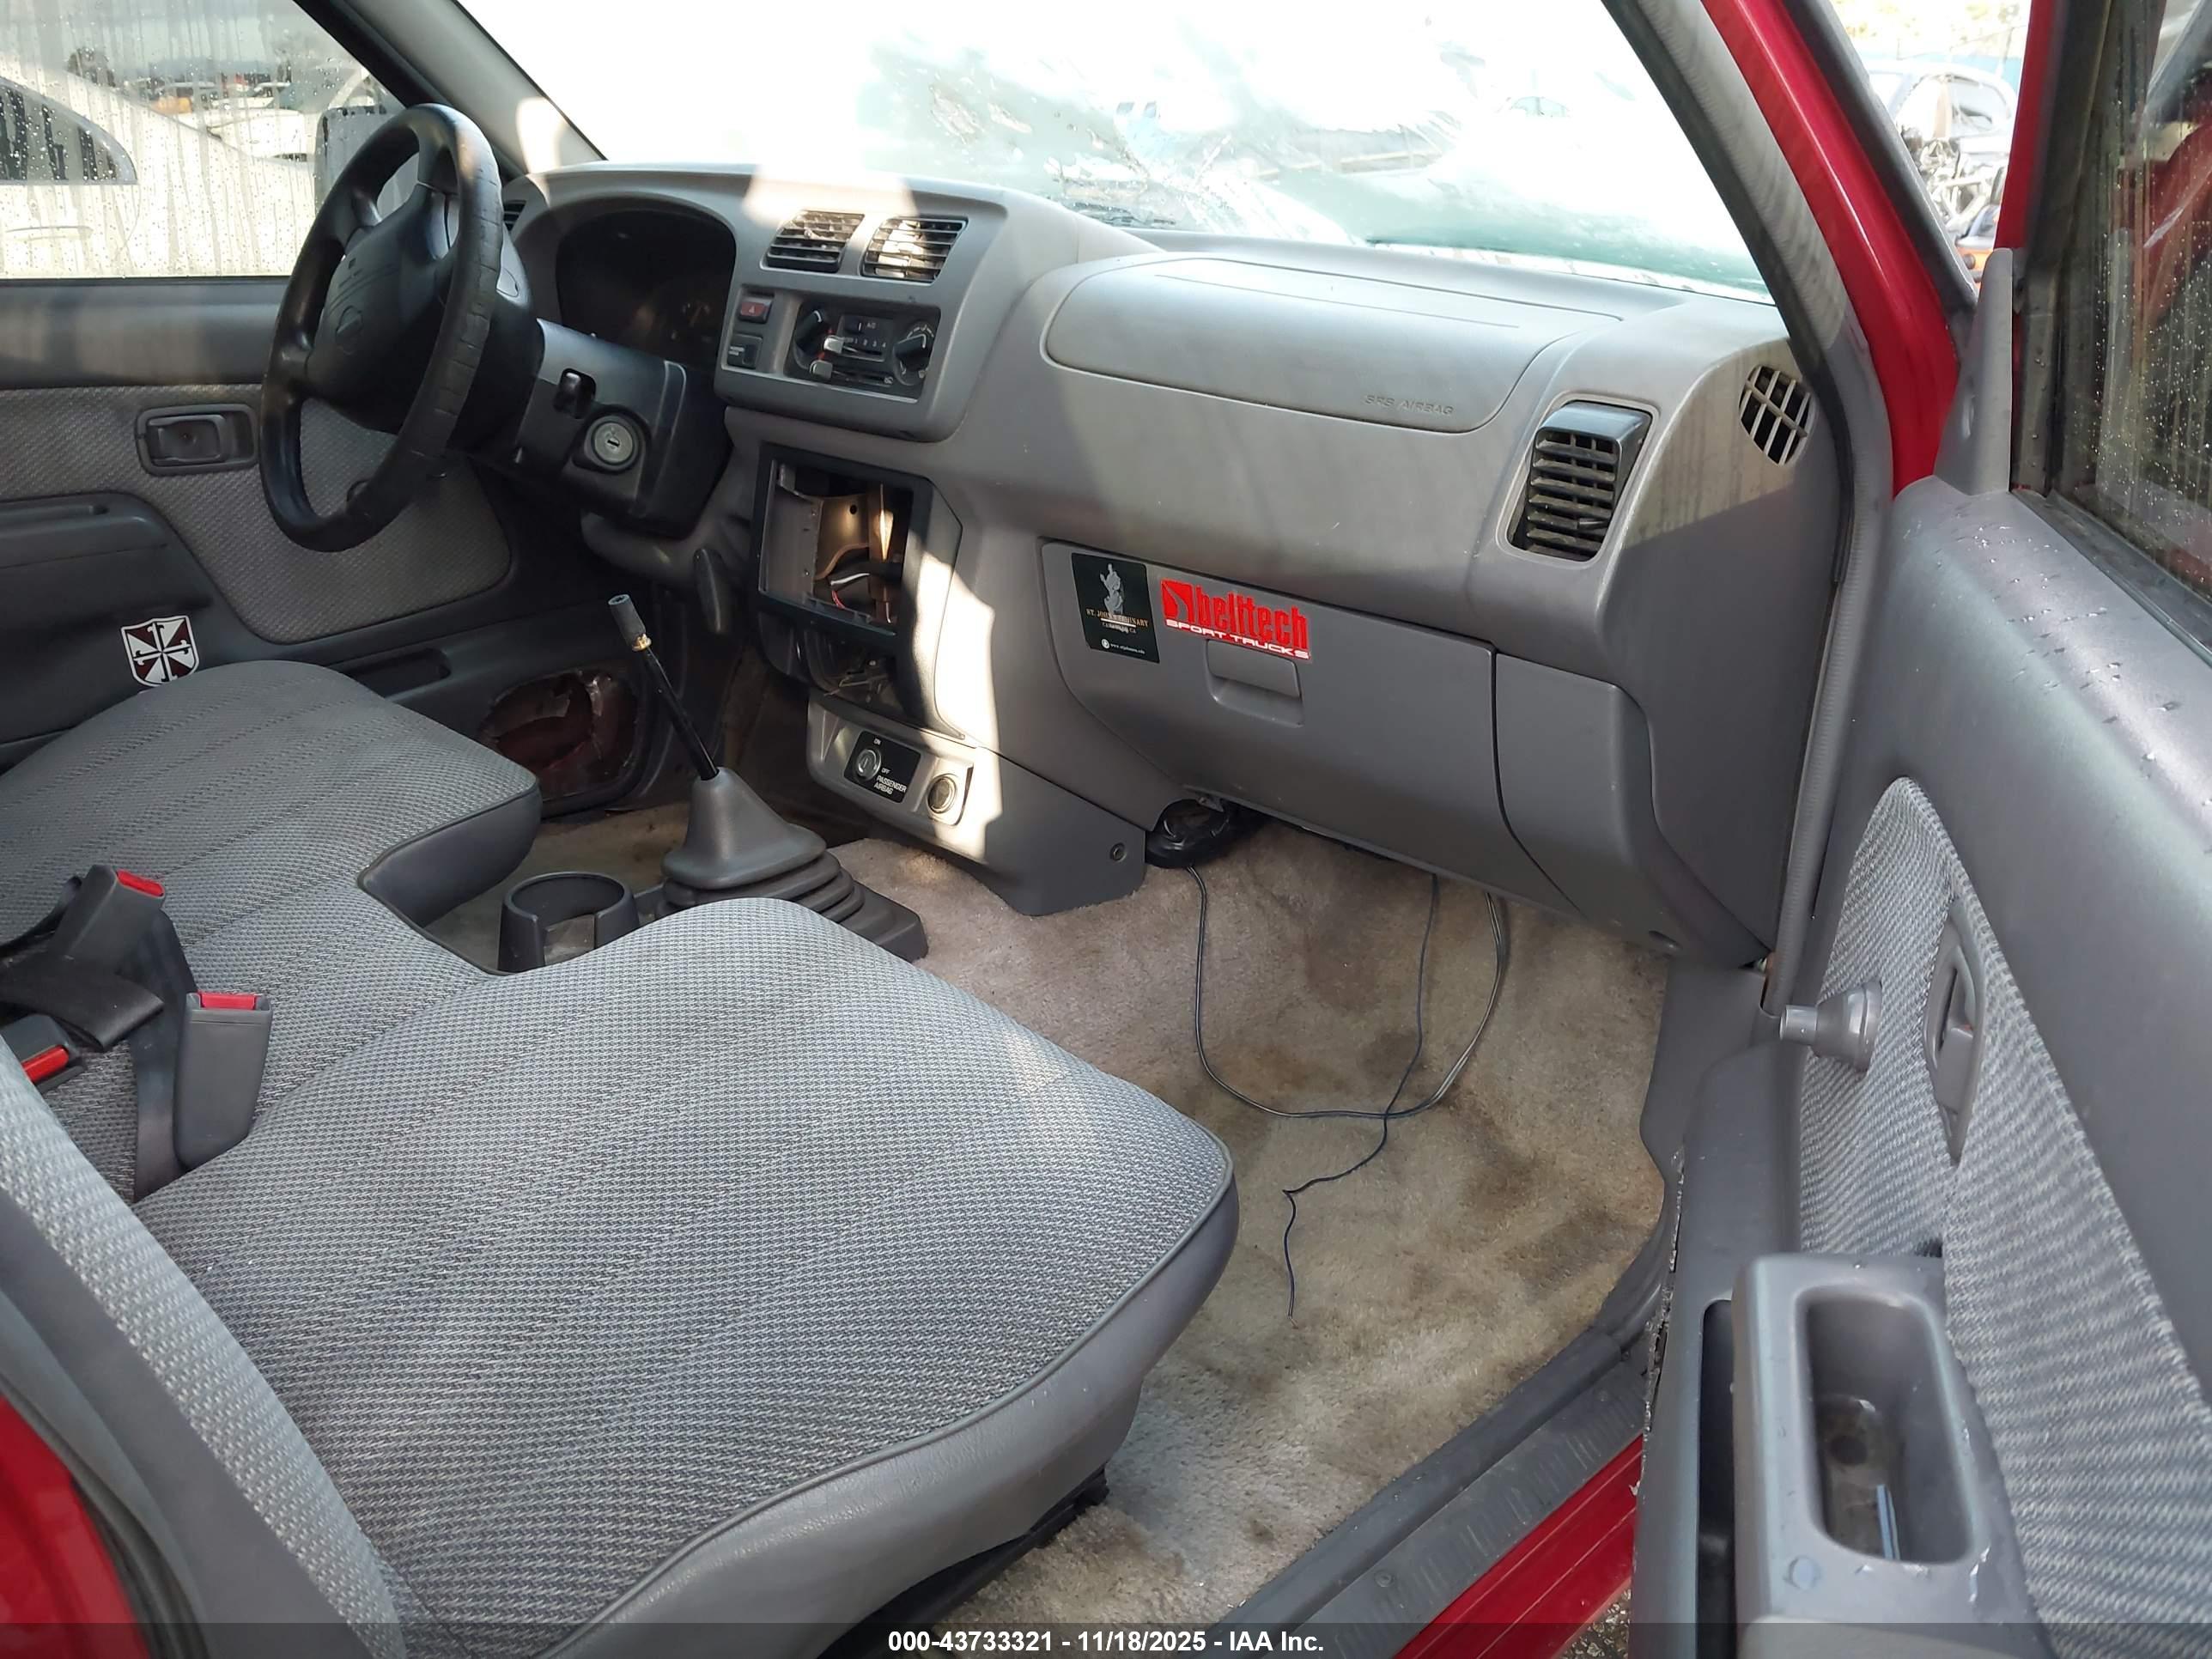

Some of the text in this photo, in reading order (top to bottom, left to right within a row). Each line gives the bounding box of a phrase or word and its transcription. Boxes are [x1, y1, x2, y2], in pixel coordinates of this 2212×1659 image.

[1398, 398, 1455, 416] AIRBAG
[1165, 618, 1310, 660] SPORT TRUCKS
[873, 781, 894, 795] AIRBAG
[876, 775, 908, 793] PASSENGER
